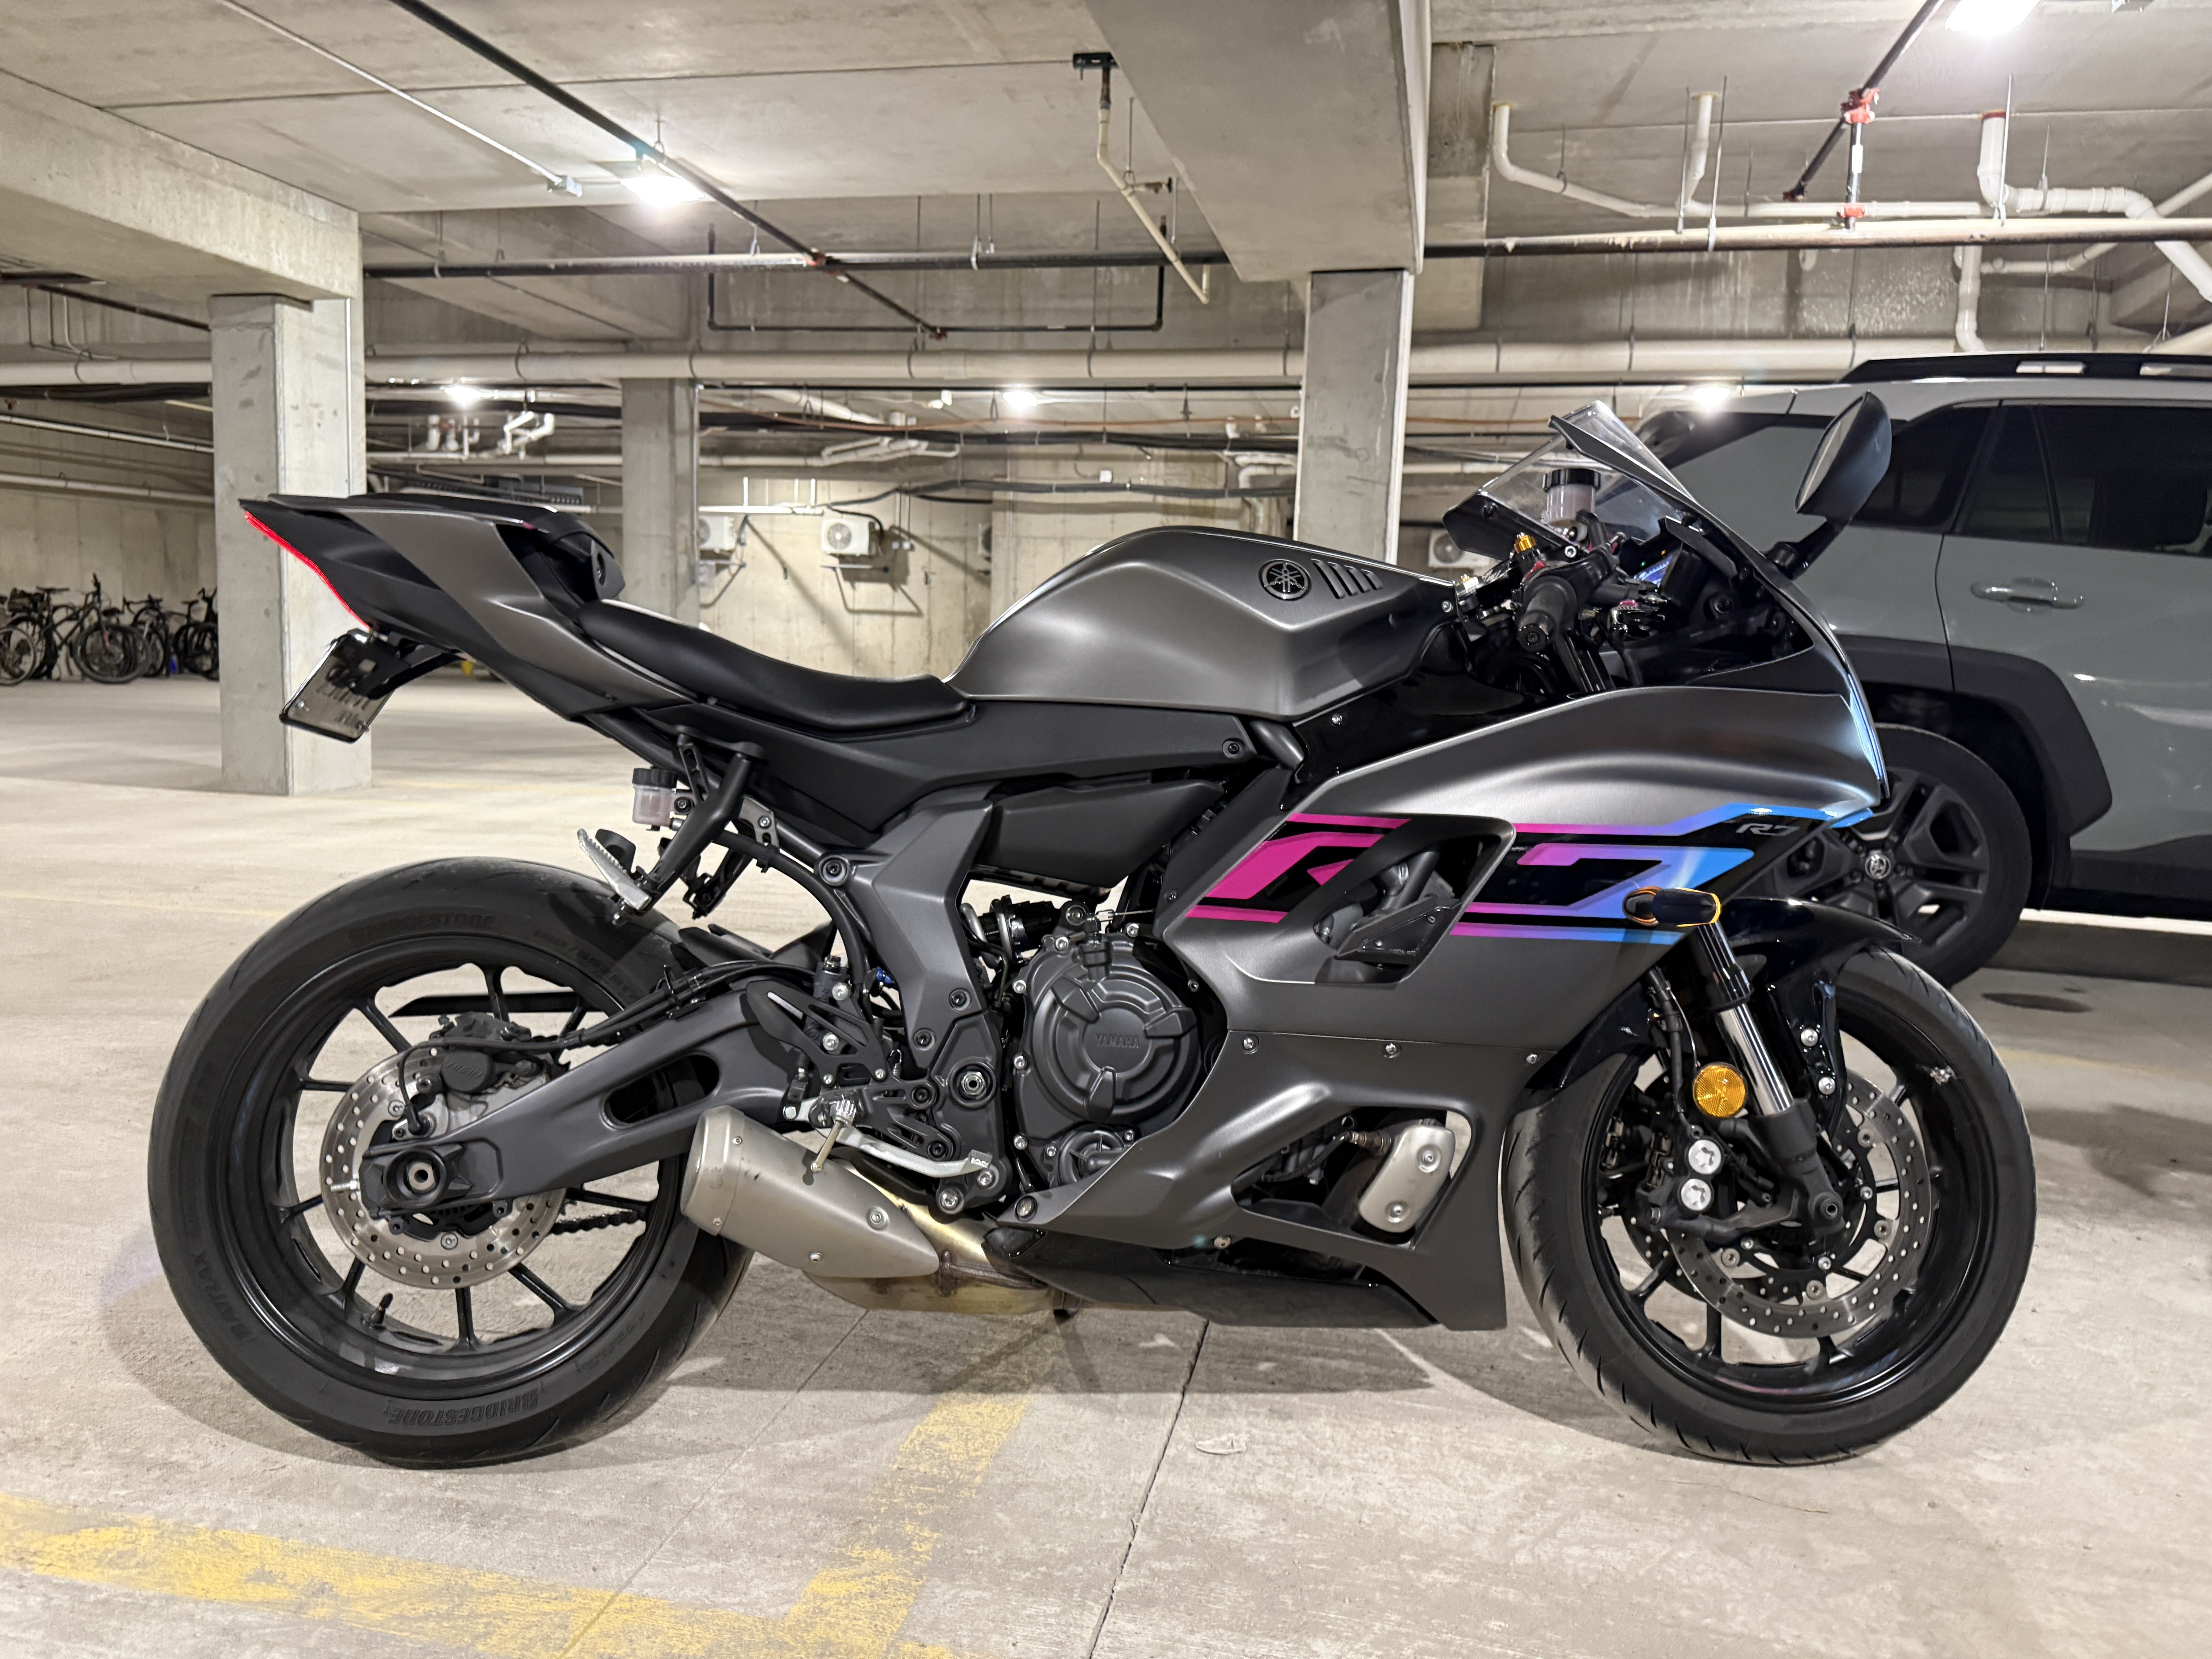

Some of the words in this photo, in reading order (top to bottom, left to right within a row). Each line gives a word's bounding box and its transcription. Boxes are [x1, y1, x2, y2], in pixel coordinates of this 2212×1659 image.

[1736, 823, 1800, 836] R7
[1094, 1032, 1140, 1049] YAMAHA
[387, 1388, 538, 1427] BRIDGESTONE
